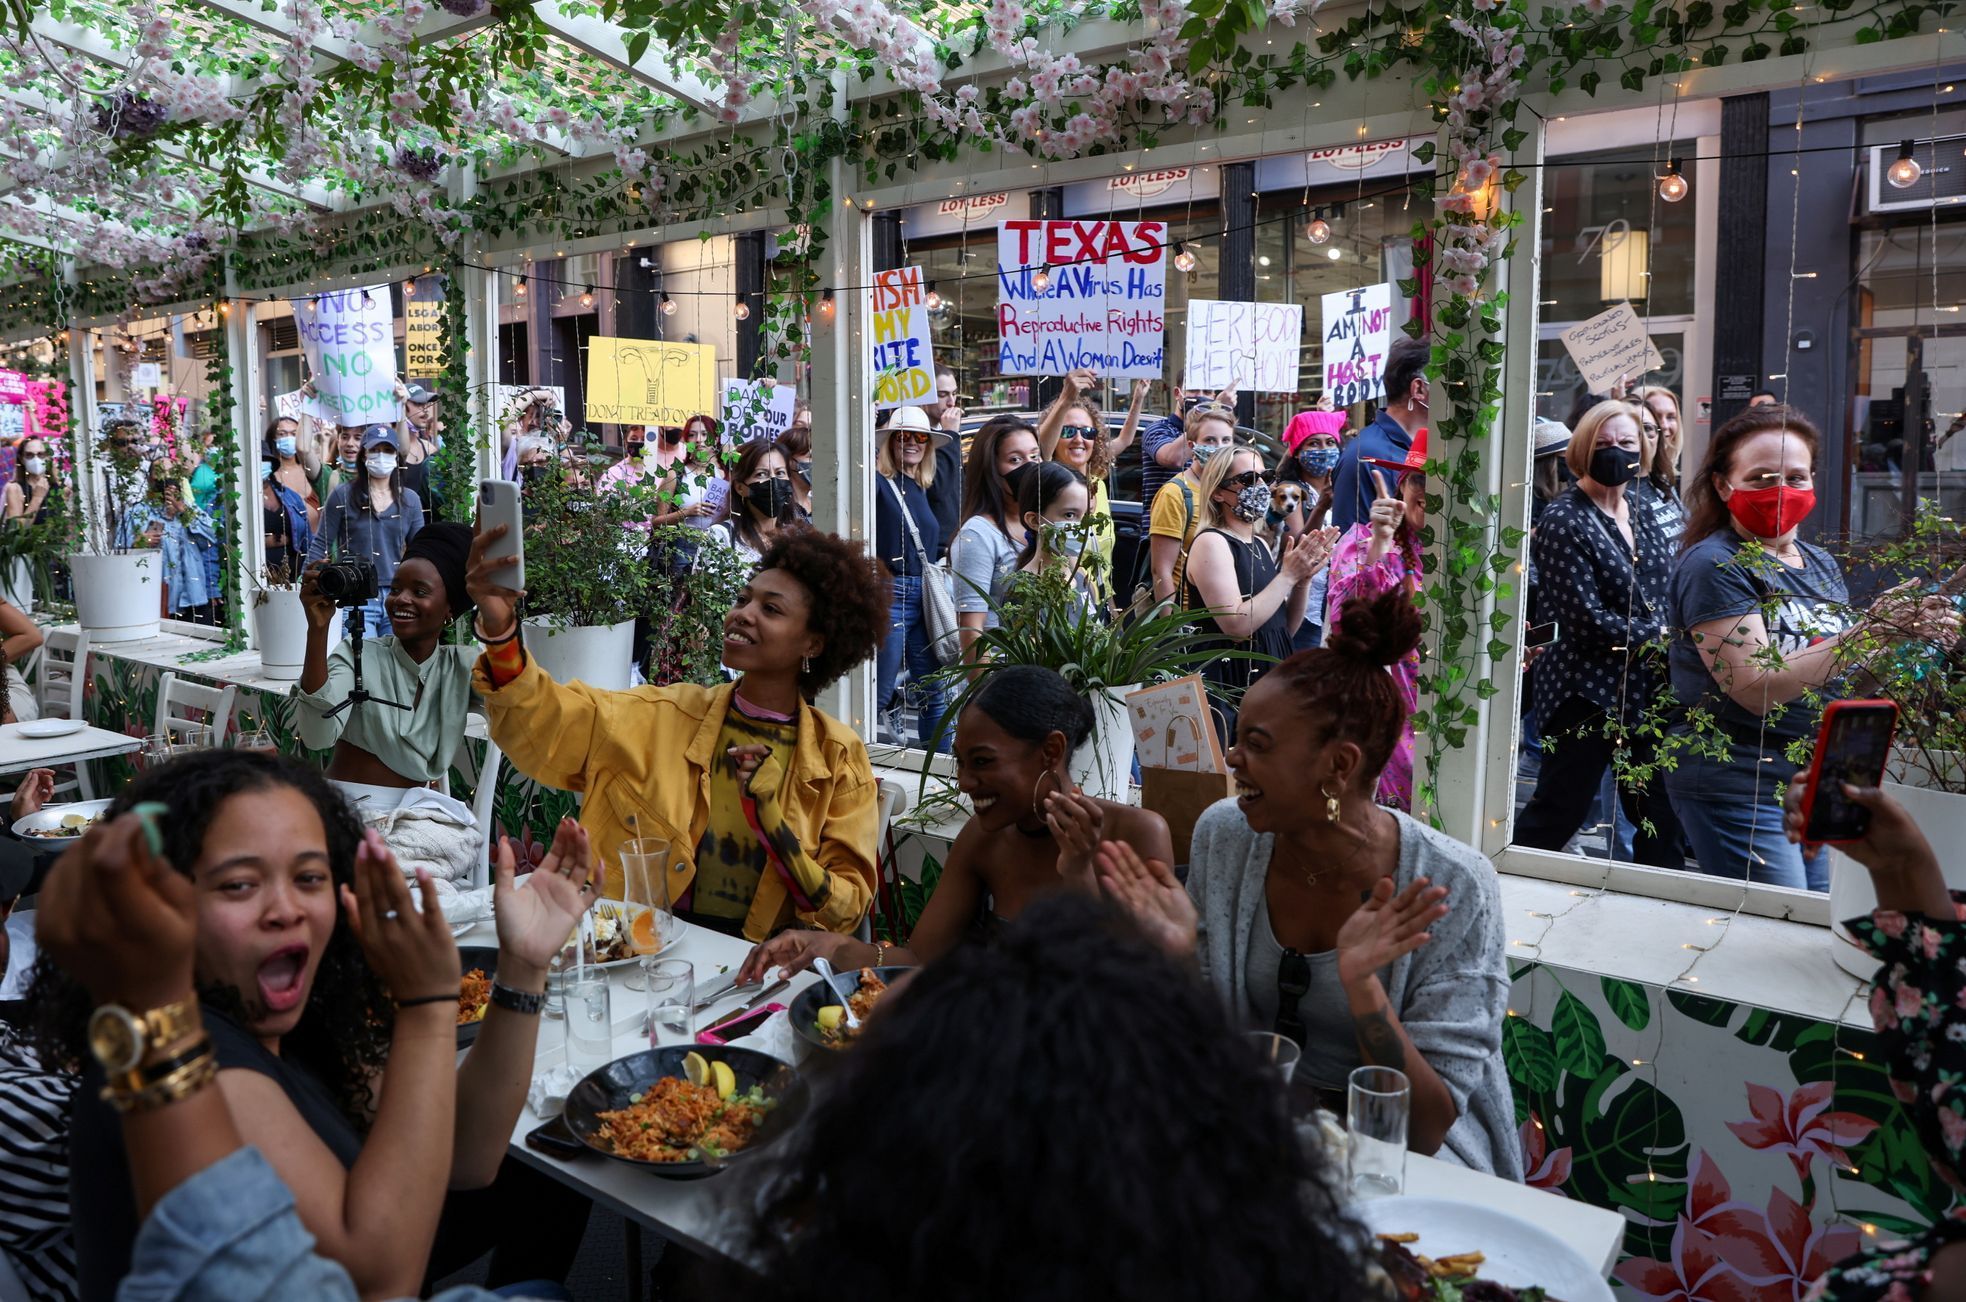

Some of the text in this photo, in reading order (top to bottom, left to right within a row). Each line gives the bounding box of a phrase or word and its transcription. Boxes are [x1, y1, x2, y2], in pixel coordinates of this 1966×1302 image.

[1005, 221, 1163, 265] TEXAS
[1577, 218, 1630, 265] 79
[1056, 267, 1075, 299] A
[1127, 268, 1163, 299] Has
[1346, 289, 1366, 315] I
[301, 319, 384, 345] ACCESS
[875, 308, 911, 343] MY
[1000, 303, 1163, 344] Reproductive Rights
[1192, 302, 1245, 348] HER
[1326, 306, 1391, 343] AM NOT
[323, 351, 373, 378] NO
[408, 344, 438, 352] ONCE
[410, 355, 434, 364] FOR
[1001, 340, 1036, 373] And
[1041, 339, 1059, 373] A
[1350, 337, 1366, 361] A
[1189, 347, 1244, 388] HER
[1327, 353, 1382, 390] HOST
[627, 405, 670, 421] TREAD
[764, 408, 787, 427] OUR
